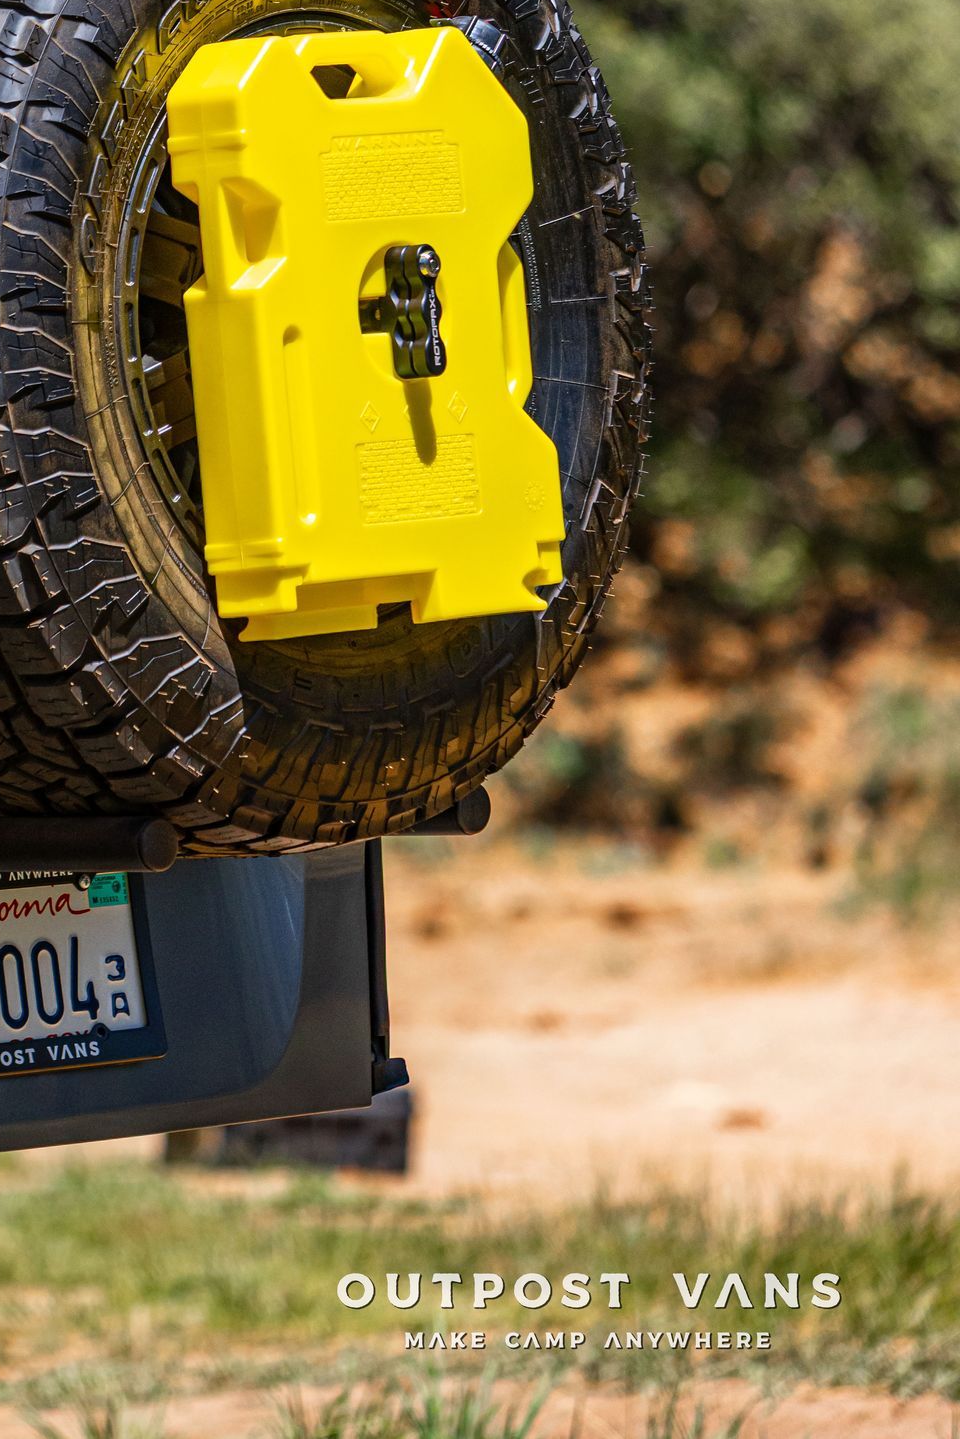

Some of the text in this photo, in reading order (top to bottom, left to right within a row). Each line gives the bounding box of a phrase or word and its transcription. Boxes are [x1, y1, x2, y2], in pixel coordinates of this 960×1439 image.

[333, 131, 444, 152] WARNING
[429, 298, 442, 366] ROTOPAX
[46, 1040, 100, 1061] VANS
